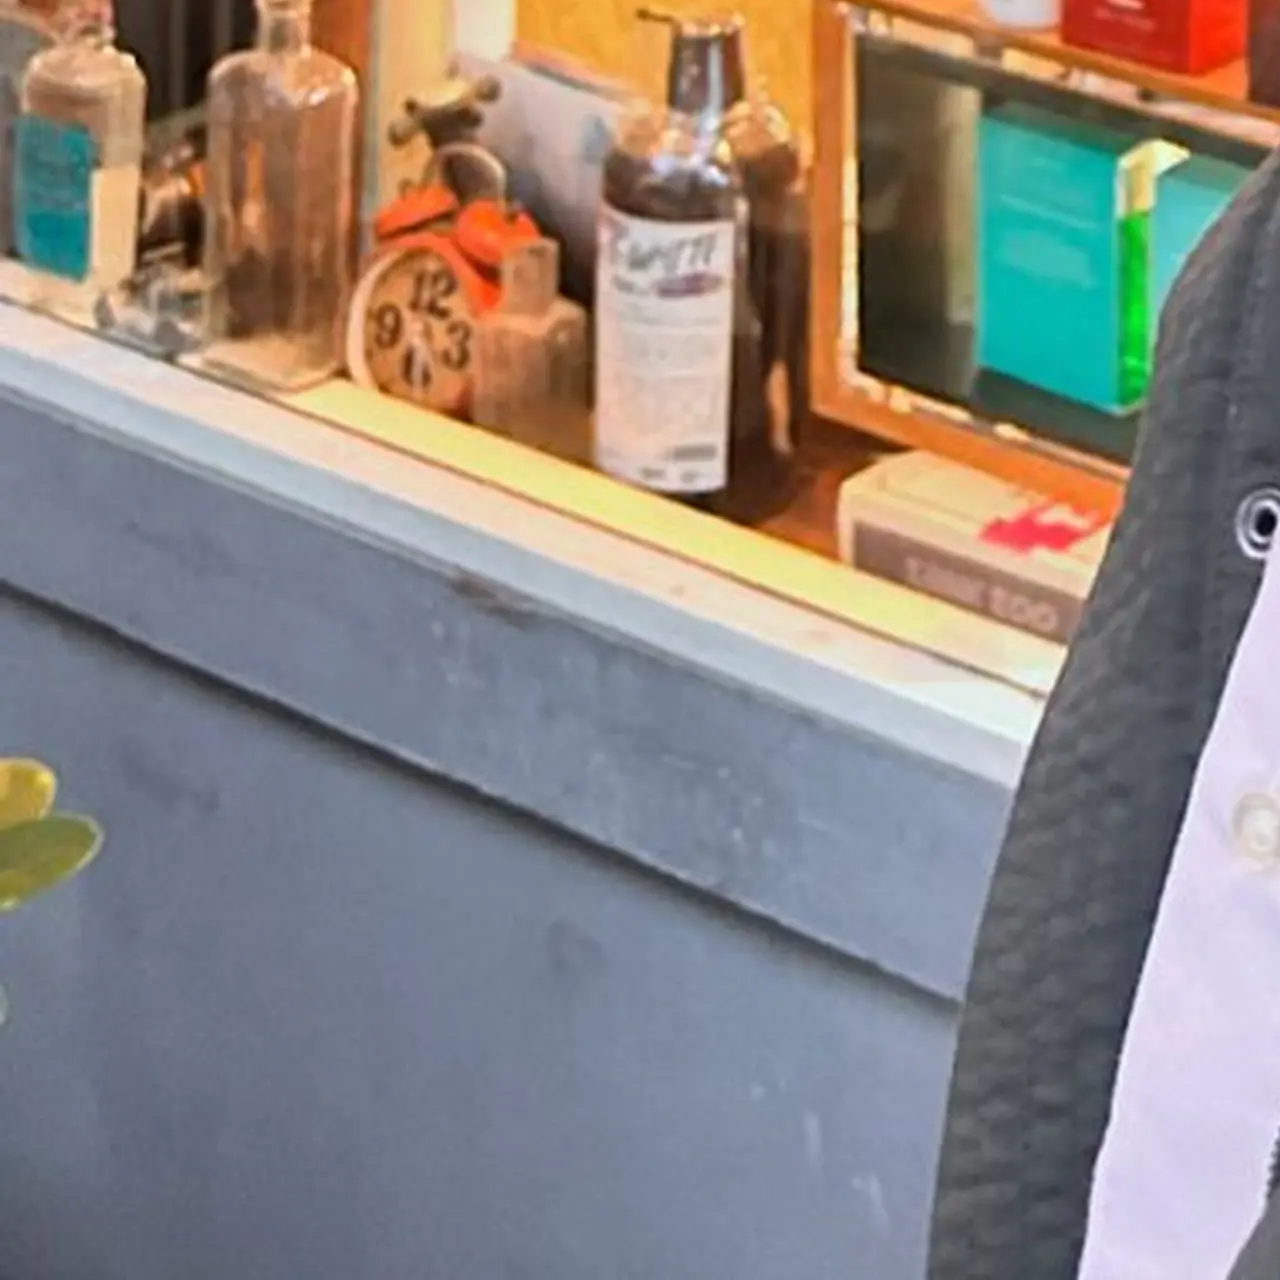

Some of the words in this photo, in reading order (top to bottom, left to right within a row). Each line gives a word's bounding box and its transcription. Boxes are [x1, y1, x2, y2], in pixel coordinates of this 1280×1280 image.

[408, 269, 457, 319] 12
[374, 303, 401, 349] 9
[440, 320, 471, 372] 3
